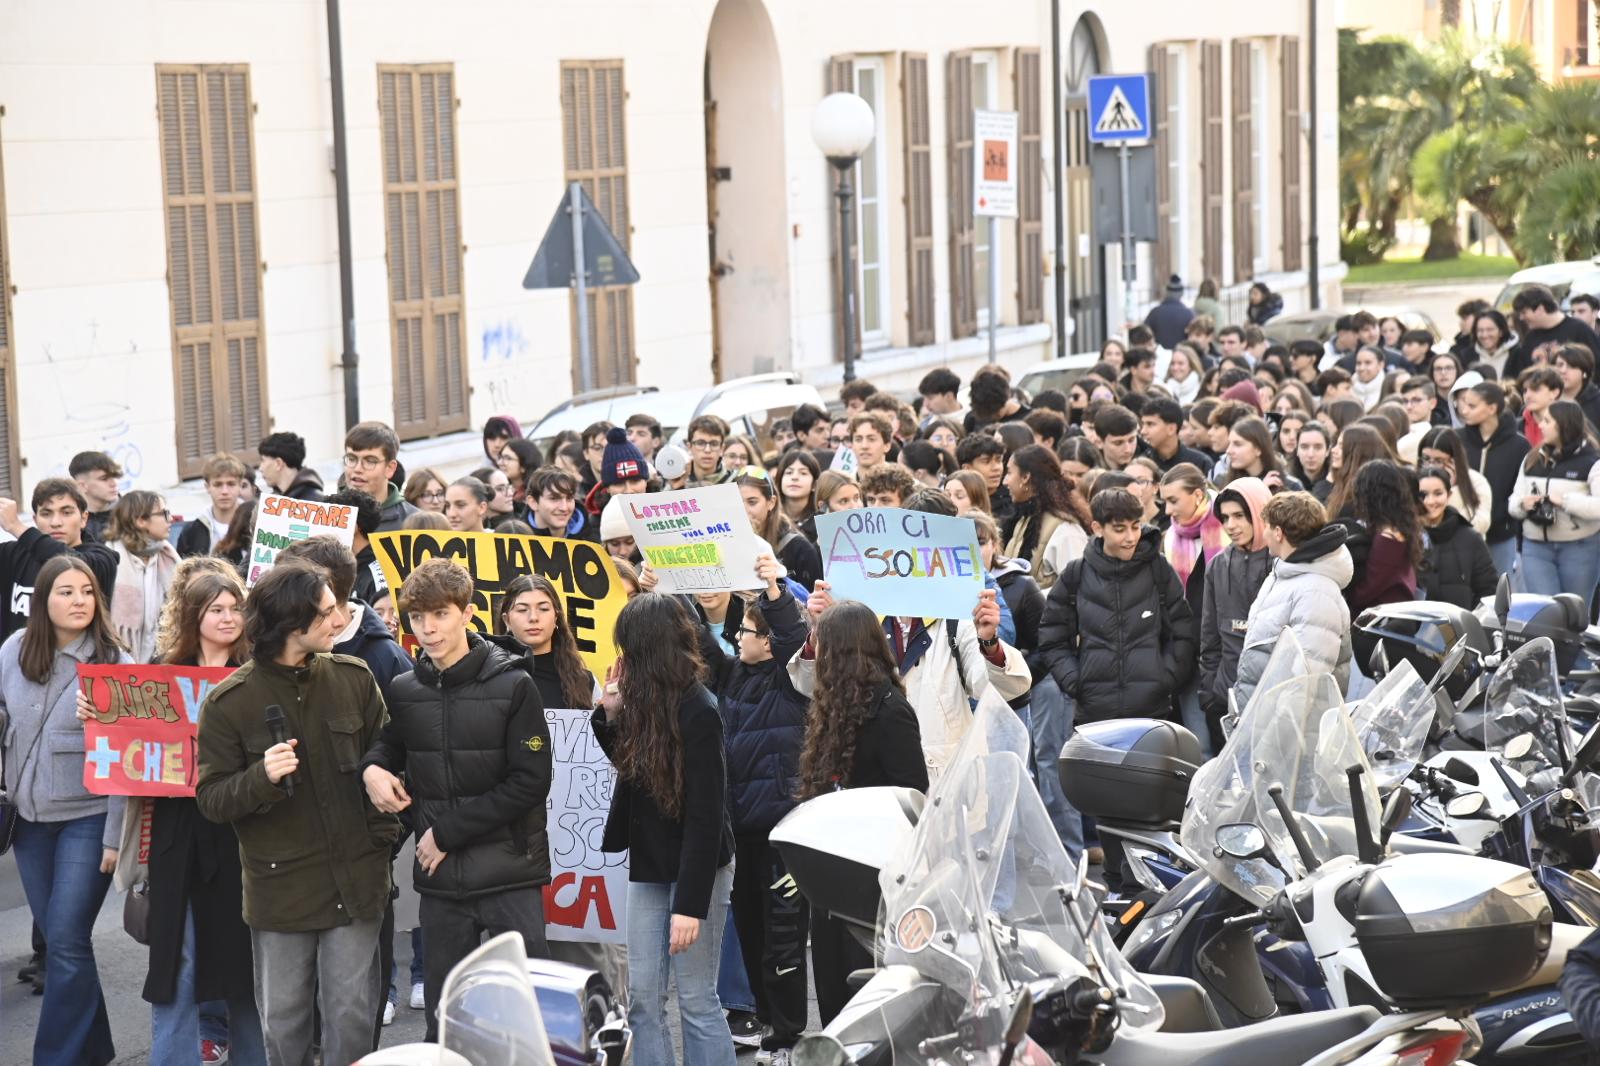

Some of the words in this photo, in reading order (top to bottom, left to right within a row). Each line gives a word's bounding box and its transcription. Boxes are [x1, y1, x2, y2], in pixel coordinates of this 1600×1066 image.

[263, 497, 351, 529] SPOSTARE
[646, 516, 691, 531] INSIEME
[847, 512, 886, 534] ORA
[645, 543, 717, 565] VINCERE
[825, 526, 981, 581] ASCOLTATE!
[1502, 997, 1561, 1019] Beverly
